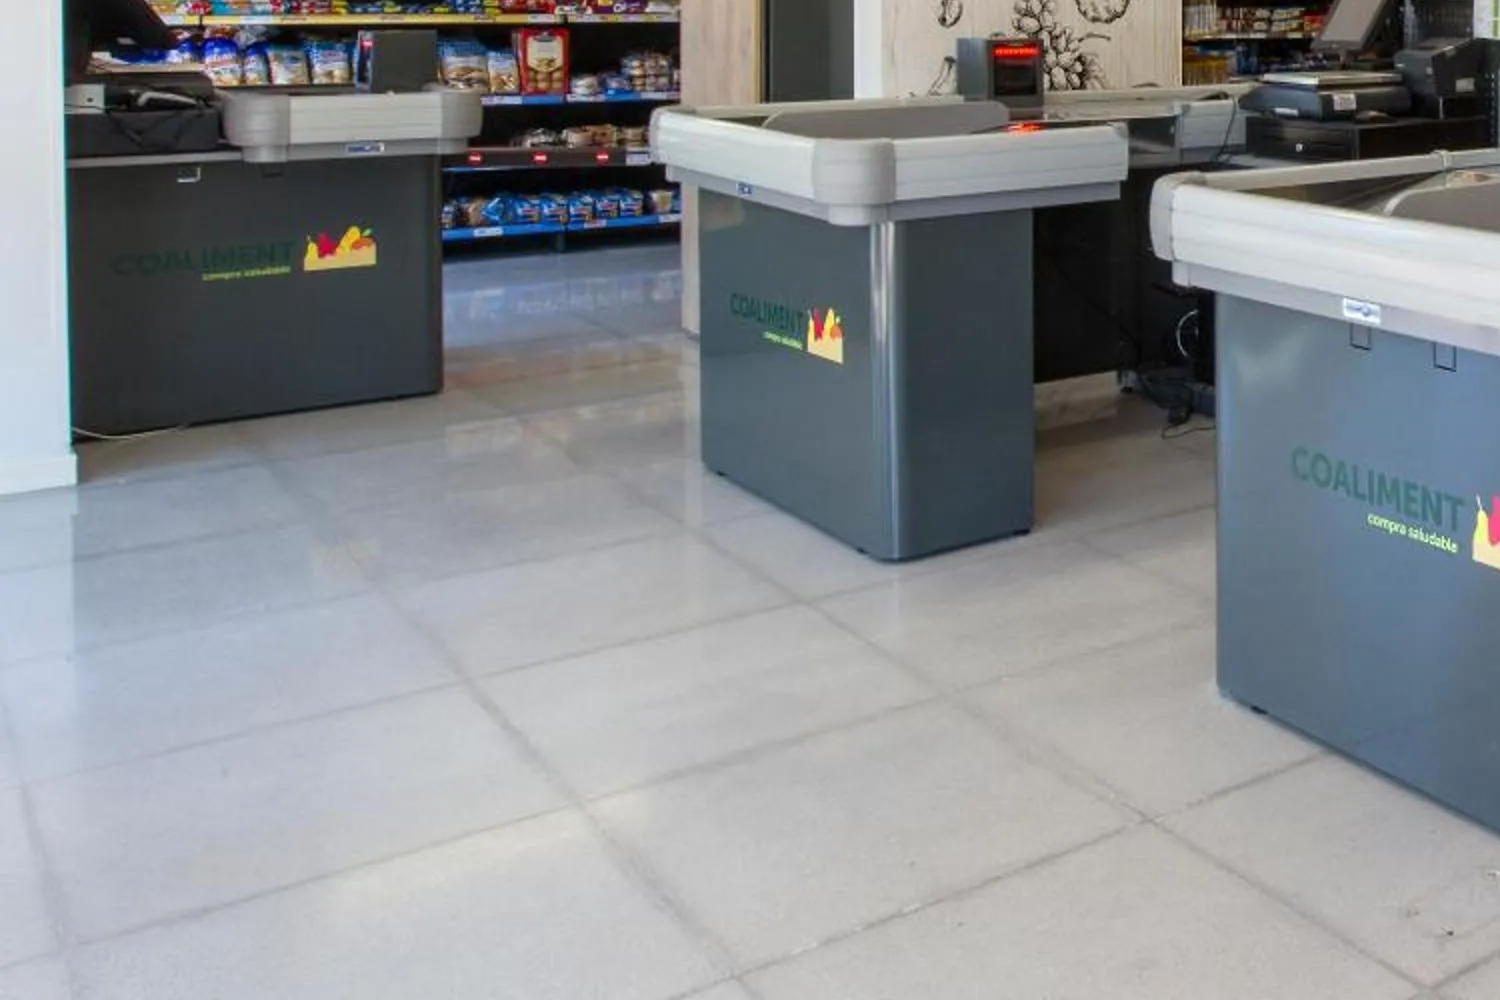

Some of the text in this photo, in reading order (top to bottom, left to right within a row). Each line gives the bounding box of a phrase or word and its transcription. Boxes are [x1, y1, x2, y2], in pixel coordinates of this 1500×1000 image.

[111, 242, 296, 276] COALIMENT
[1290, 446, 1467, 532] COALIMENT
[1366, 512, 1458, 554] compra saludable
